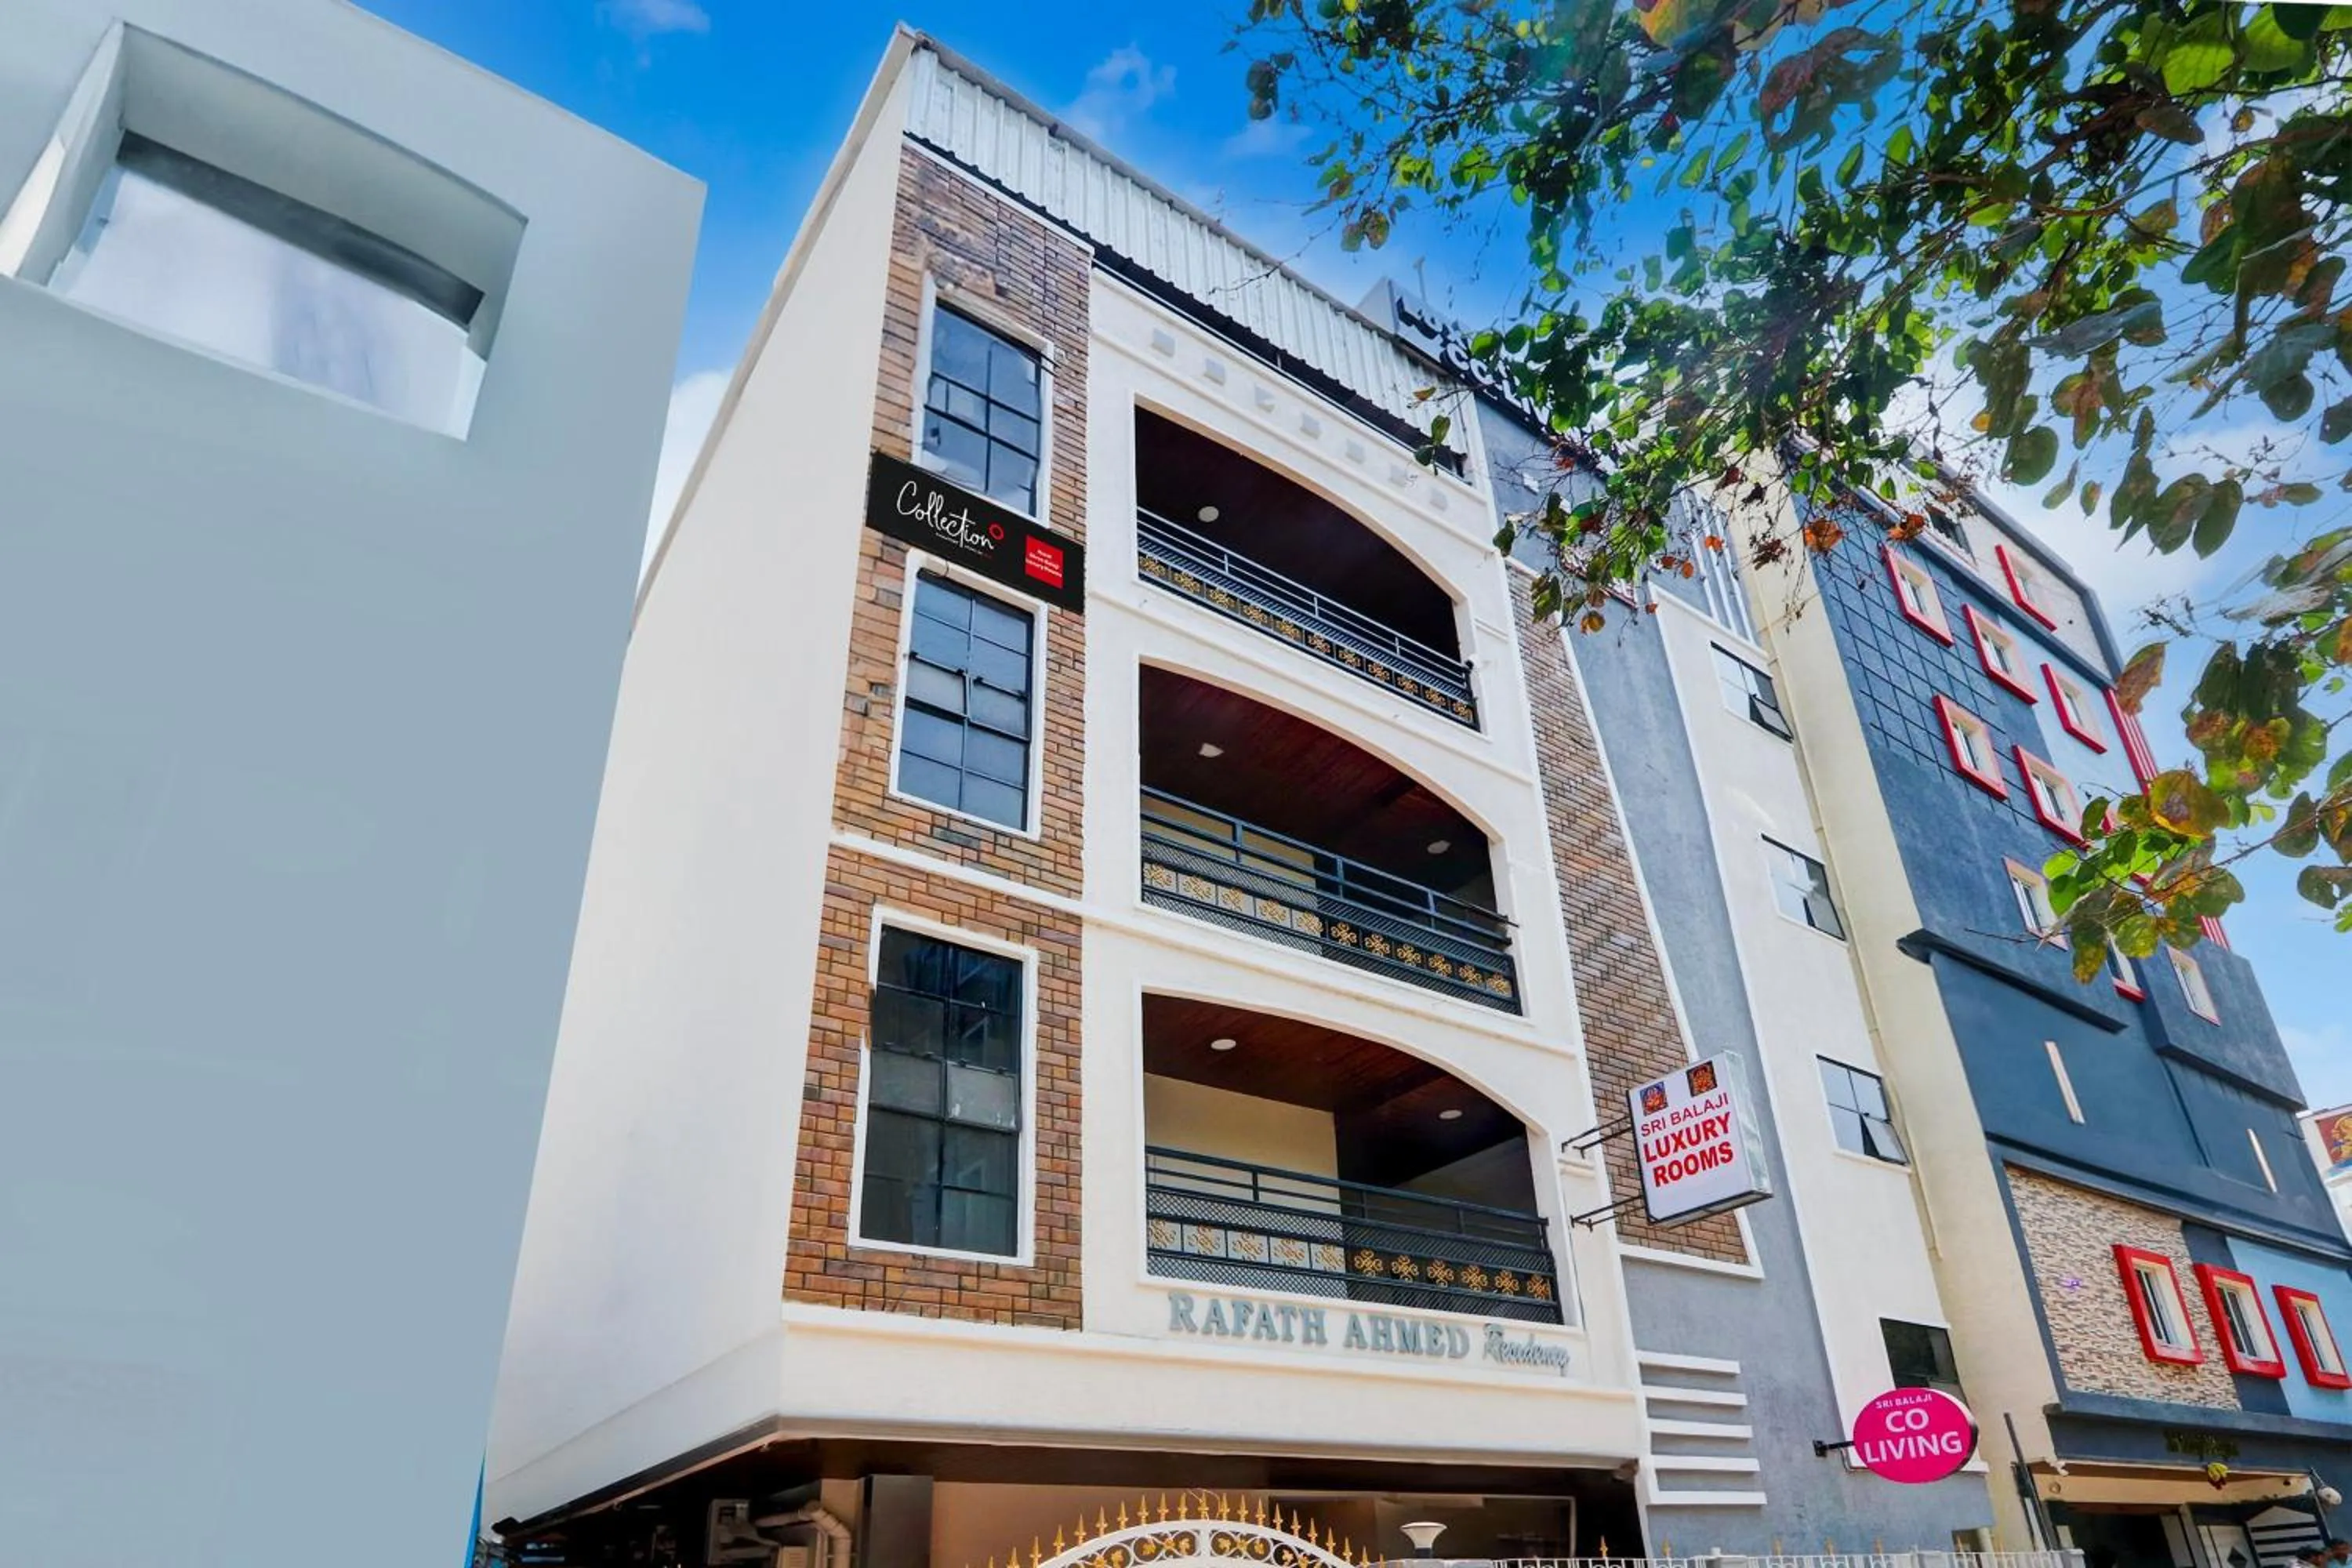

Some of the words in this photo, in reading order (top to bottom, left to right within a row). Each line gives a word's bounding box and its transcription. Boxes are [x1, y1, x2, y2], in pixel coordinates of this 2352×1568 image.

[896, 481, 994, 550] Collection
[1640, 1116, 1666, 1137] SRI
[1670, 1092, 1729, 1126] BALAJI
[1643, 1111, 1731, 1163] LUXURY
[1653, 1142, 1733, 1187] ROOMS
[1167, 1290, 1328, 1345] RAFATH
[1344, 1312, 1470, 1359] AHMED
[1875, 1399, 1893, 1409] SRI
[1896, 1393, 1933, 1406] BALAJI
[1886, 1408, 1929, 1433] CO
[1863, 1431, 1962, 1463] LIVING
